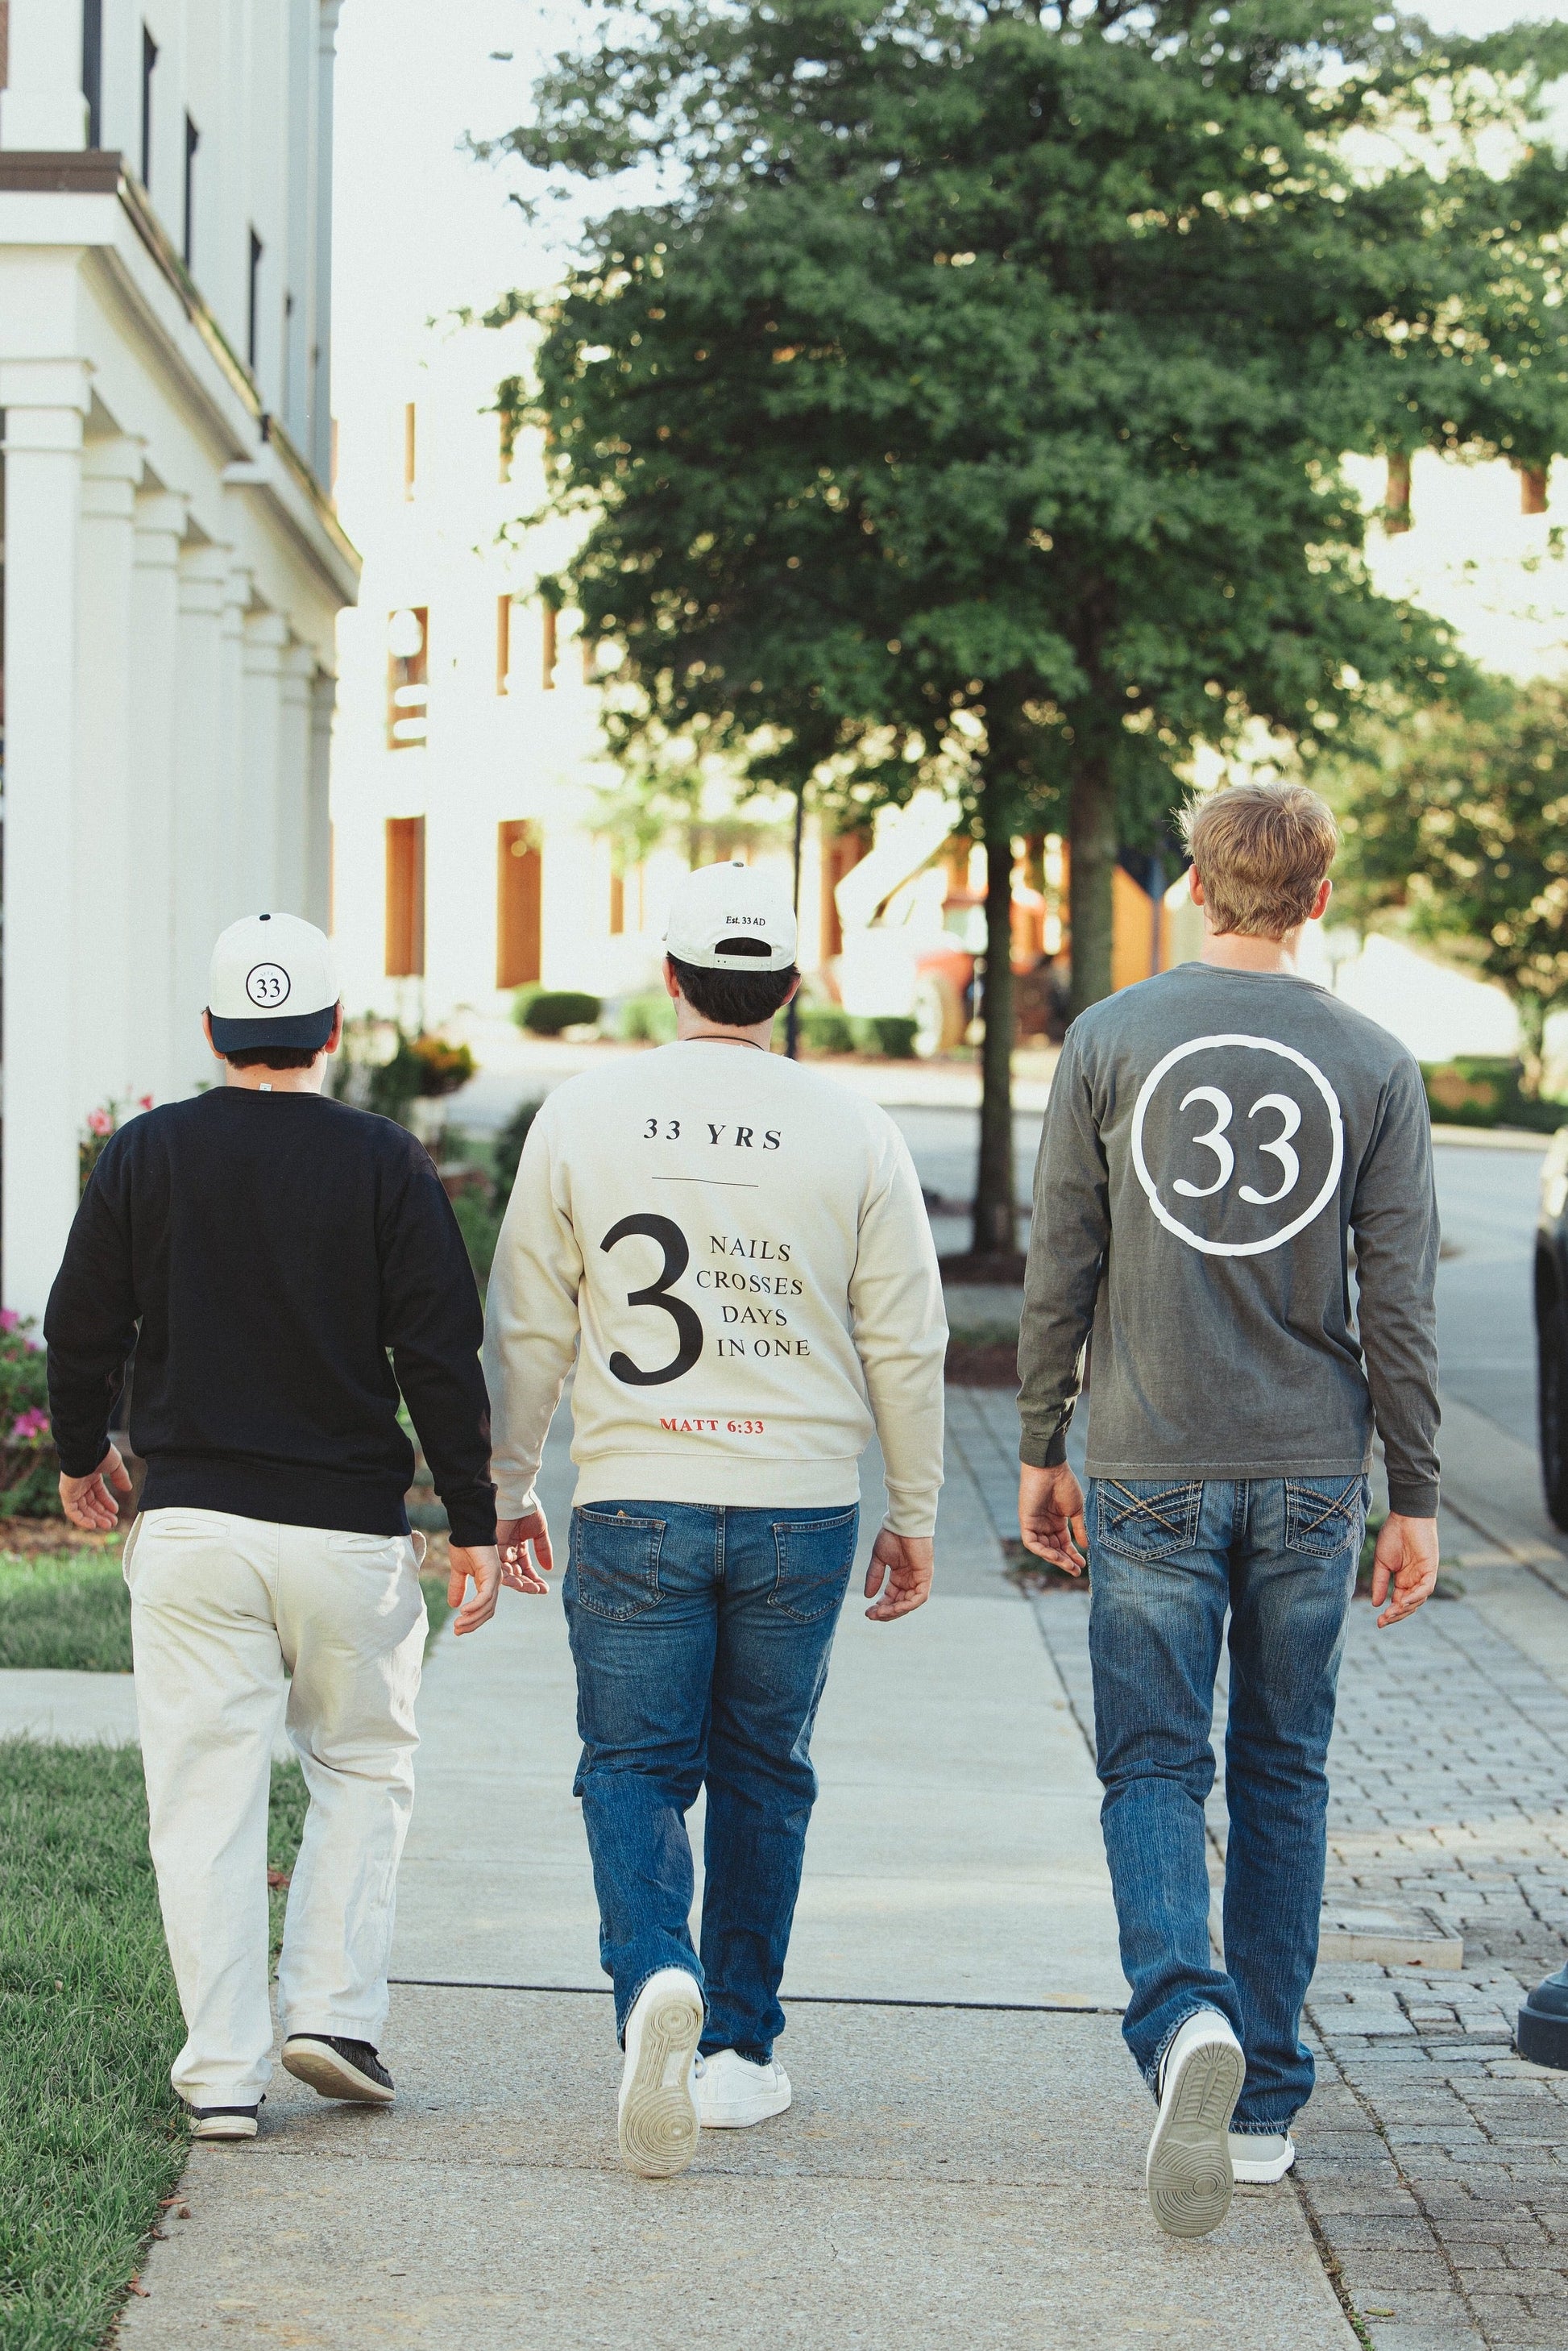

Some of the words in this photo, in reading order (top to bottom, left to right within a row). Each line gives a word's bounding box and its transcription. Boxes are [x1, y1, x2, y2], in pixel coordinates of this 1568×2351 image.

[725, 916, 740, 924] Est.
[741, 916, 752, 924] 33
[753, 917, 765, 926] AD
[256, 978, 280, 999] 33
[643, 1118, 681, 1140] 33
[707, 1124, 782, 1150] YRS
[1172, 1086, 1301, 1205] 33
[709, 1235, 791, 1262] NAILS
[696, 1270, 803, 1296] CROSSES
[599, 1213, 703, 1386] 3
[721, 1306, 788, 1327] DAYS
[716, 1339, 745, 1357] IN
[753, 1339, 811, 1358] ONE
[659, 1418, 719, 1432] MATT
[727, 1420, 765, 1435] 6:33
